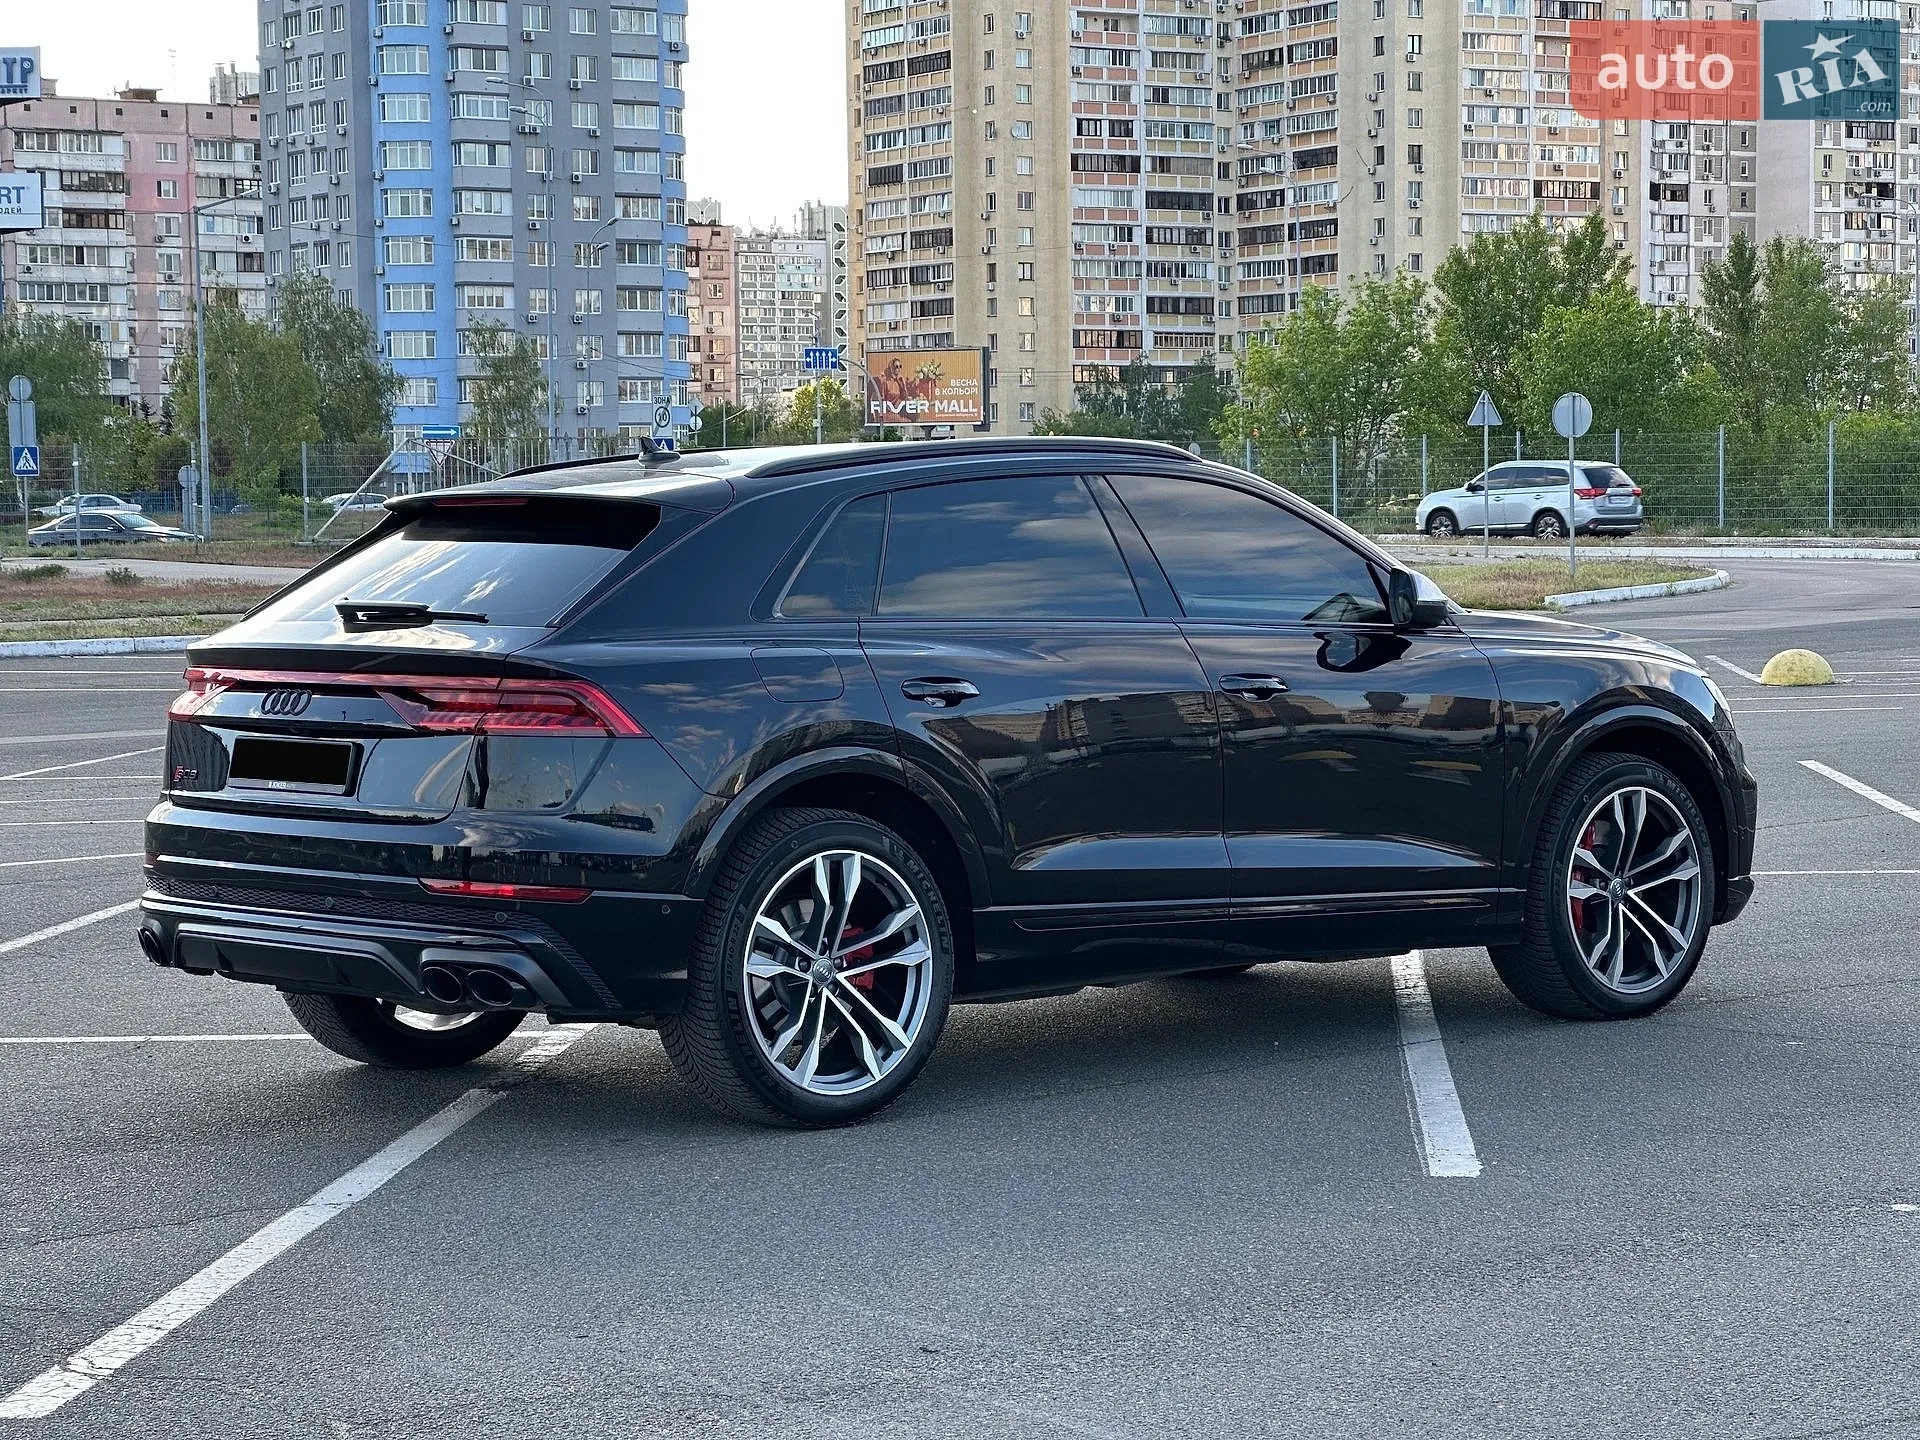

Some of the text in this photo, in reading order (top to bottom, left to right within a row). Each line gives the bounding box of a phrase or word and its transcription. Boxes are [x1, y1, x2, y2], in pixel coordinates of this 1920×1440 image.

[950, 379, 978, 387] ВЕСНА
[942, 388, 978, 396] КОЛЬОРІ
[653, 396, 671, 405] ЗОНА
[871, 400, 978, 414] RIVER MALL
[906, 859, 951, 956] MICHELIN
